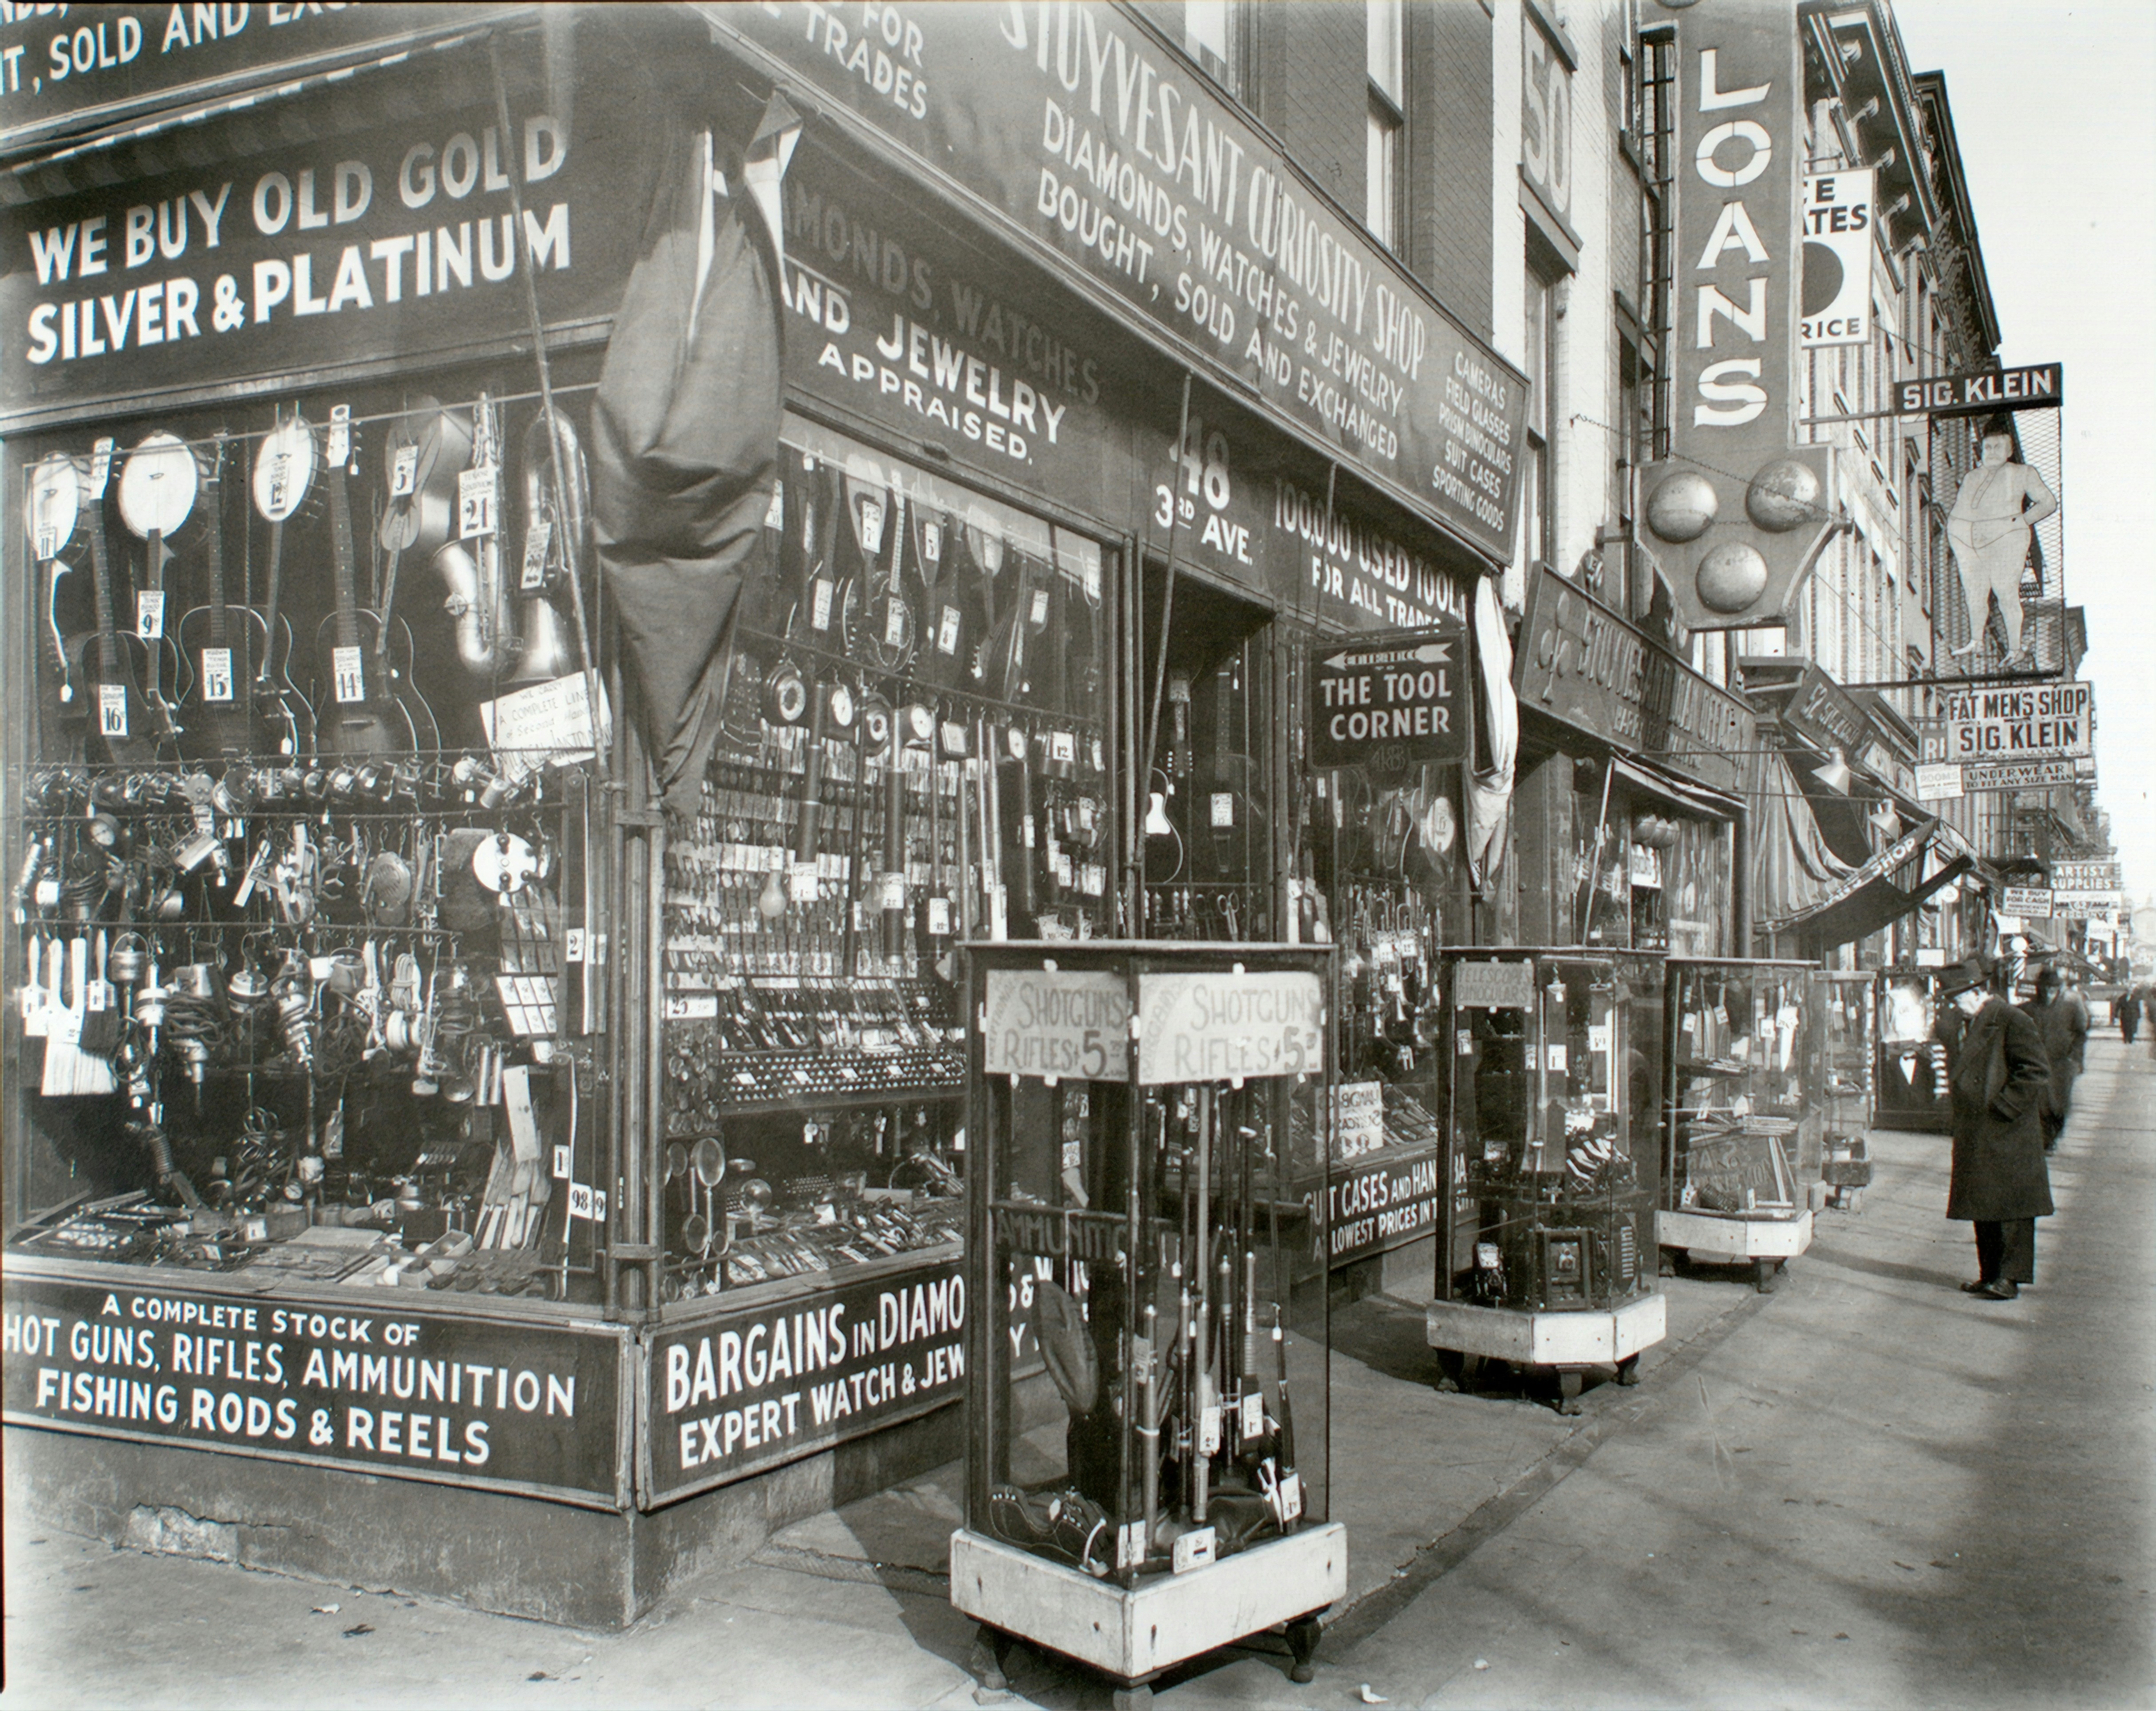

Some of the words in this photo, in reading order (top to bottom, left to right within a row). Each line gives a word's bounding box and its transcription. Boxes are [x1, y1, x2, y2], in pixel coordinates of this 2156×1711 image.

[49, 16, 142, 81] SOLD
[161, 3, 250, 54] AND
[804, 3, 927, 120] TRADES
[863, 3, 923, 68] FOR
[28, 215, 108, 285] WE
[126, 182, 234, 269] BUY
[252, 160, 373, 236] OLD
[399, 115, 569, 209] GOLD
[999, 3, 1244, 227] STUYVESANT
[1248, 166, 1370, 336] CURIOSITY
[1373, 284, 1425, 381] SHOP
[1043, 96, 1192, 265] DIAMONDS,
[1200, 222, 1299, 341] WATCHES
[1304, 319, 1318, 355] &
[1320, 331, 1403, 418] JEWELRY
[1694, 48, 1772, 428] LOANS
[27, 277, 201, 364] SILVER
[212, 274, 245, 333] &
[253, 203, 571, 323] PLATINUM
[1037, 167, 1159, 302] BOUGHT,
[1175, 272, 1236, 344] SOLD
[1245, 327, 1291, 386] AND
[1298, 366, 1398, 461] EXCHANGED
[818, 342, 1033, 465] APPRAISED.
[876, 312, 1066, 444] JEWELRY
[1455, 351, 1506, 410] CAMERAS
[1903, 380, 1958, 410] SIG.
[1965, 369, 2052, 403] KLEIN
[1445, 375, 1470, 415] FIELD
[1472, 399, 1510, 445] GLASSES
[1168, 415, 1230, 510] 48
[1438, 402, 1464, 440] PRISM
[1465, 422, 1512, 475] BINOCULARS
[1445, 439, 1467, 473] SUIT
[1469, 459, 1501, 499] CASES
[465, 497, 488, 531] 21
[1432, 465, 1475, 512] SPORTING
[1476, 495, 1504, 532] GOODS
[1201, 514, 1253, 566] AVE.
[1275, 478, 1353, 562] 100,000
[1358, 526, 1410, 593] USED
[1312, 555, 1344, 599] FOR
[1350, 577, 1382, 617] ALL
[209, 673, 227, 697] 15
[340, 672, 357, 699] 14
[512, 698, 559, 721] COMPLETE
[519, 690, 534, 700] WE
[1320, 675, 1372, 707] THE
[1383, 669, 1452, 702] TOOL
[1950, 695, 1979, 720] FAT
[1984, 690, 2034, 719] MEN'S
[2038, 688, 2087, 716] SHOP
[106, 706, 122, 732] 16
[1330, 706, 1450, 741] CORNER
[1960, 725, 2006, 752] SIG.
[2010, 721, 2078, 749] KLEIN
[1968, 764, 2065, 781] UNDERWEAR
[2000, 777, 2021, 786] ANY
[1868, 837, 1915, 876] SHOP
[2050, 878, 2112, 889] SUPPLIES
[2056, 865, 2107, 876] ARTIST
[569, 935, 578, 955] 2
[1017, 981, 1124, 1030] SHOTGUNS
[1190, 983, 1322, 1031] SHOTGUNS
[1004, 1028, 1074, 1072] RIFLES
[1175, 1033, 1271, 1077] RIFLES
[1341, 1171, 1388, 1218] CASES
[1391, 1176, 1412, 1203] AND
[1331, 1217, 1375, 1255] LOWEST
[1378, 1203, 1418, 1238] PRICES
[1420, 1200, 1430, 1225] IN
[101, 1293, 121, 1316] A
[131, 1297, 258, 1331] COMPLETE
[271, 1309, 373, 1343] STOCK
[383, 1322, 420, 1346] OF
[70, 1320, 160, 1374] GUNS,
[173, 1332, 288, 1390] RIFLES,
[302, 1348, 575, 1417] AMMUNITION
[667, 1302, 846, 1413] BARGAINS
[853, 1319, 876, 1358] IN
[36, 1367, 178, 1424] FISHING
[191, 1388, 297, 1440] RODS
[309, 1408, 334, 1446] &
[347, 1407, 490, 1465] REELS
[680, 1392, 801, 1470] EXPERT
[810, 1363, 896, 1427] WATCH
[901, 1363, 916, 1396] &
